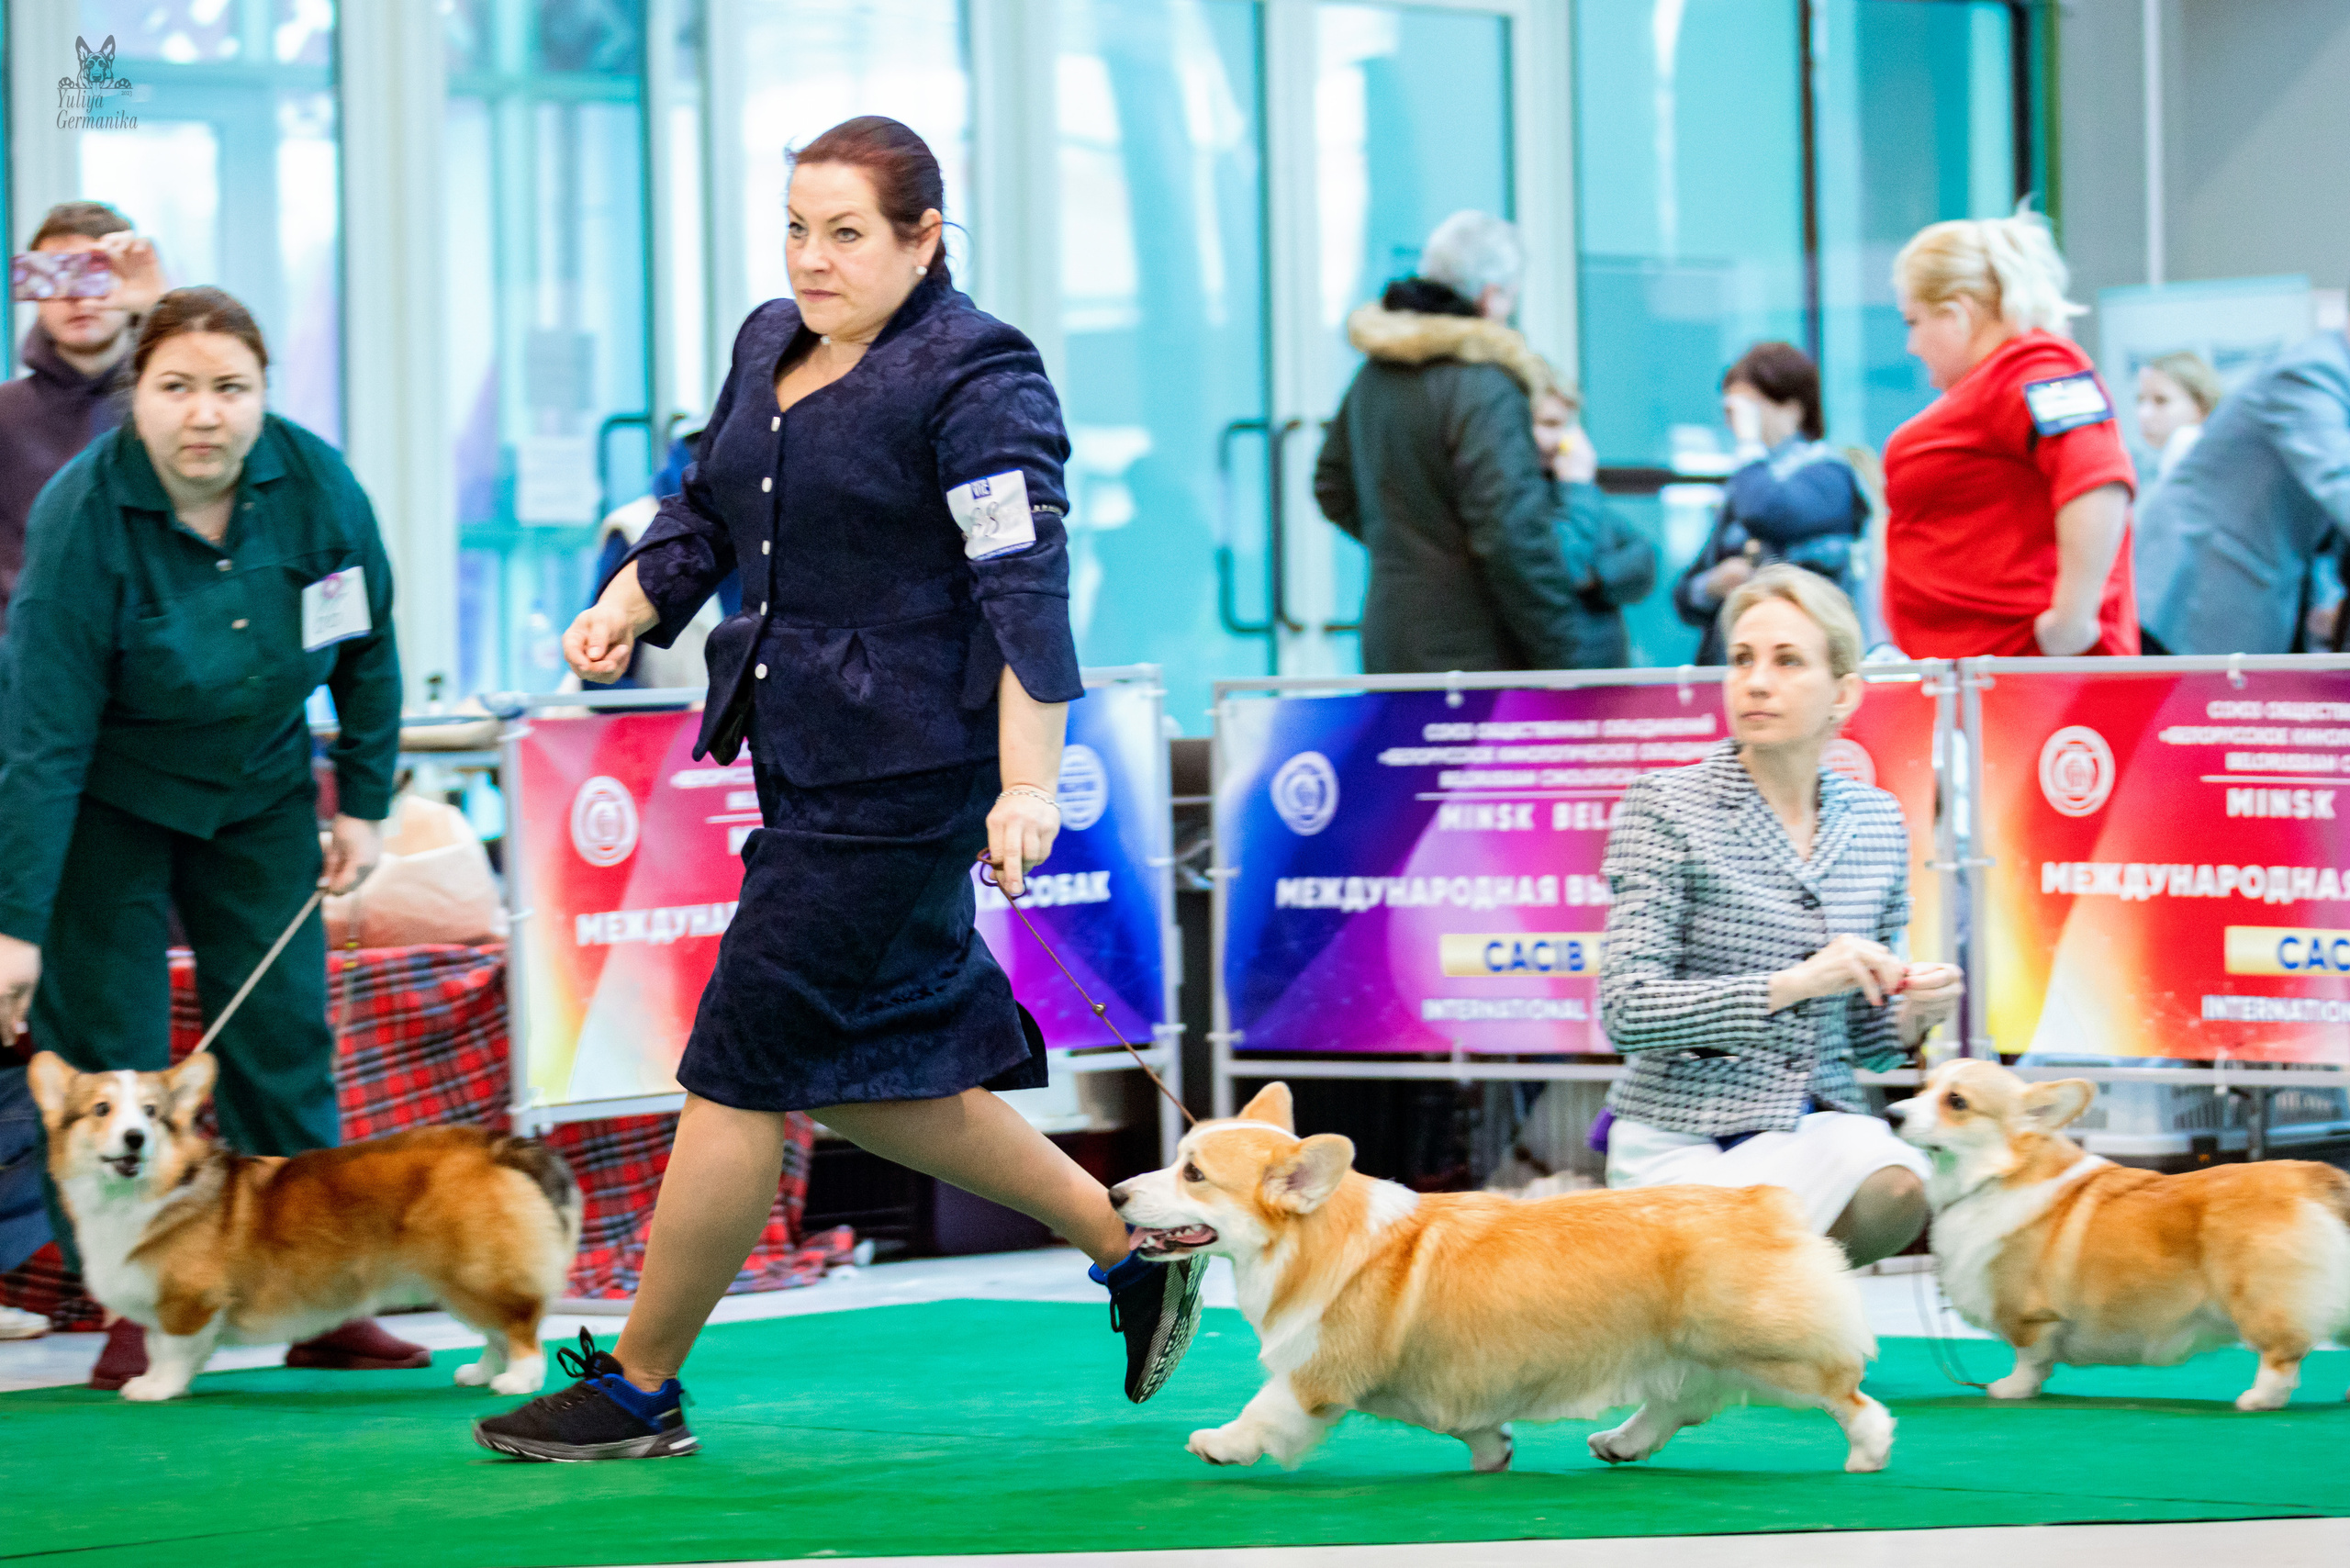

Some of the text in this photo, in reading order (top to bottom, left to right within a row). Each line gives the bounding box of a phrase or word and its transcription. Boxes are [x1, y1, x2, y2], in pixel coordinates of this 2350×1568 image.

[1438, 803, 1535, 831] MINSK
[2226, 788, 2336, 820] MINSK
[1275, 874, 1559, 913] МЕЖДУНАРОДНАЯ
[1483, 939, 1586, 973] CACIB
